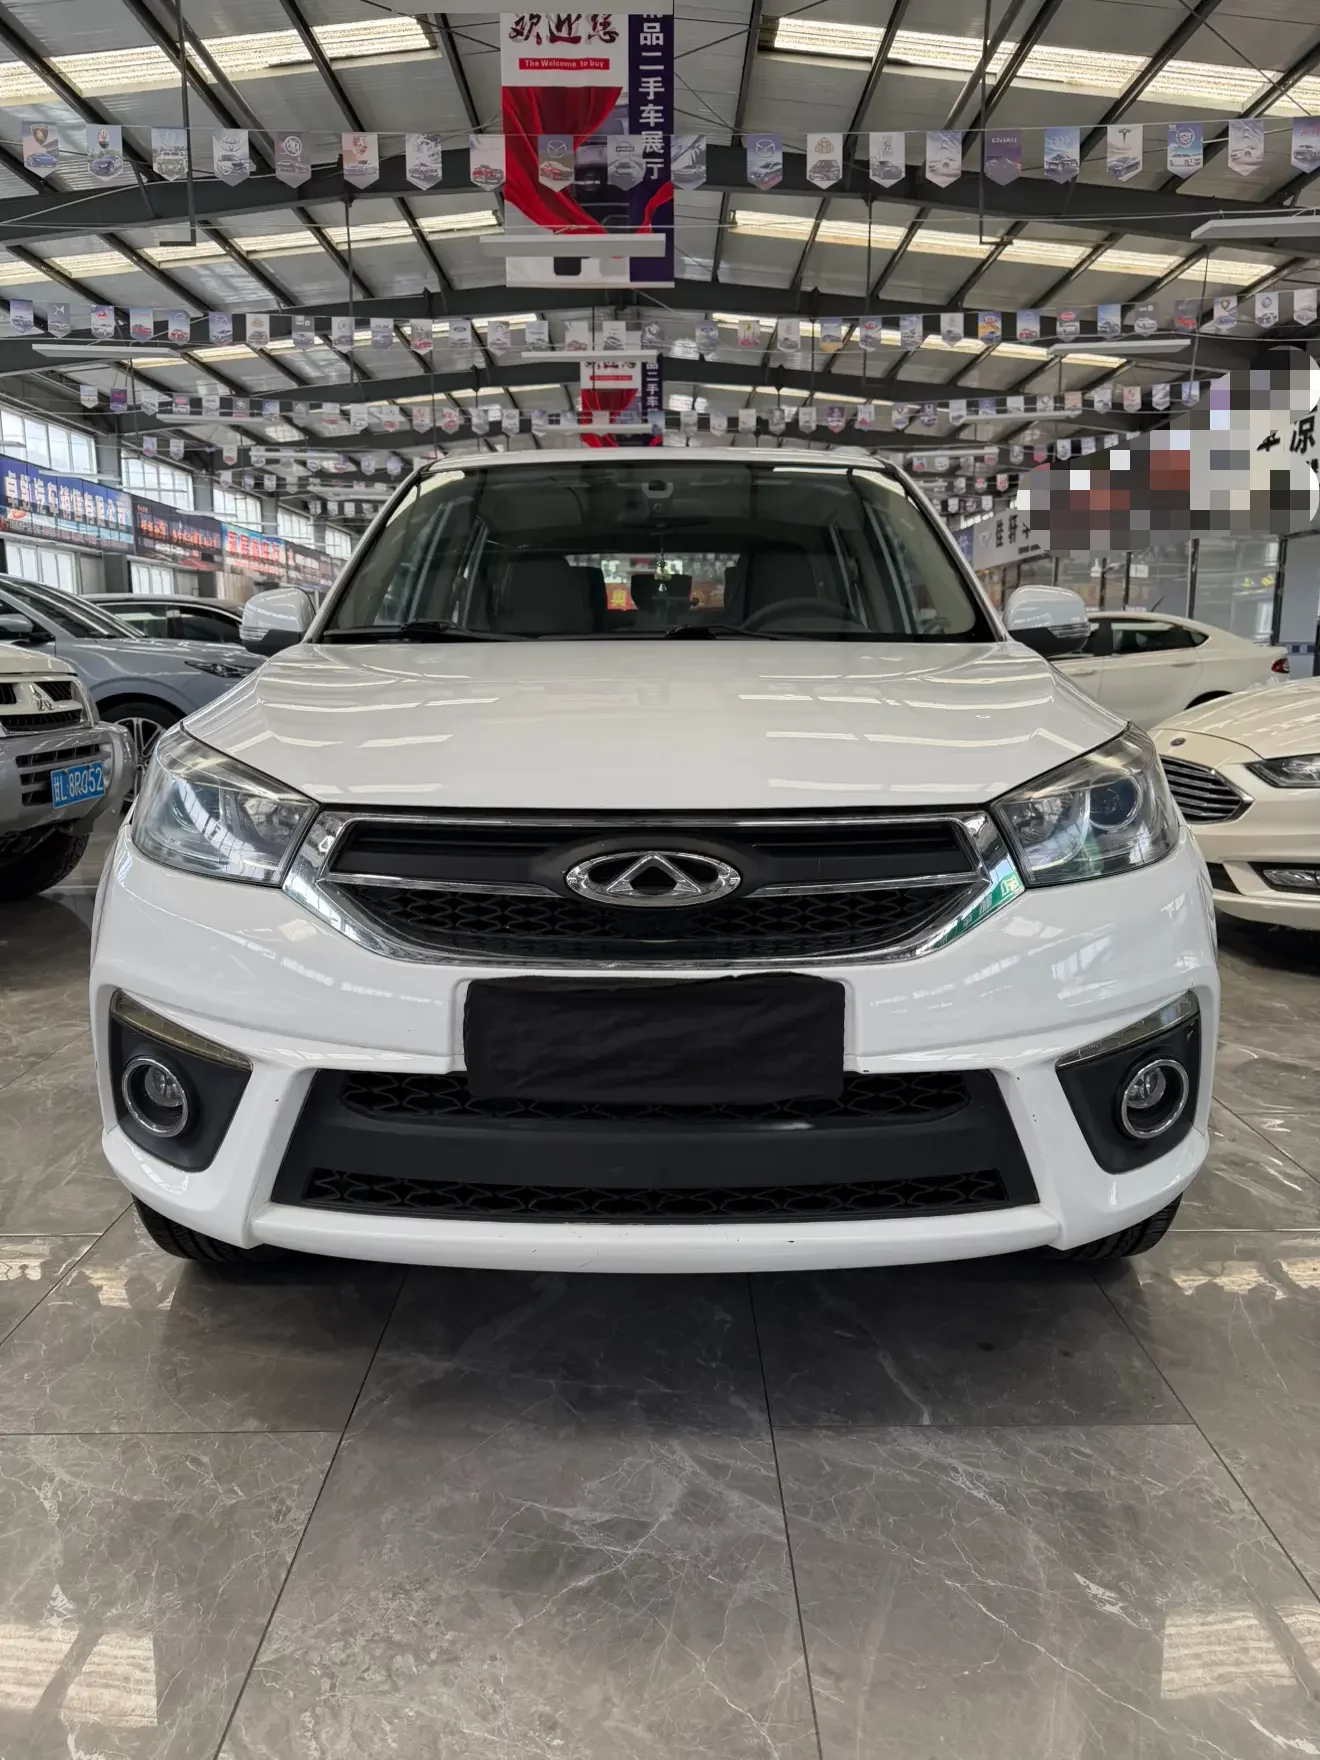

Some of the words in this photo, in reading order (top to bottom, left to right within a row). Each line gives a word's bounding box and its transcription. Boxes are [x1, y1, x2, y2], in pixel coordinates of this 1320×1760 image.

[524, 60, 540, 68] The
[541, 60, 577, 68] Welcome
[580, 60, 588, 68] to
[589, 60, 605, 69] buy
[638, 14, 666, 180] 品二手车展厅
